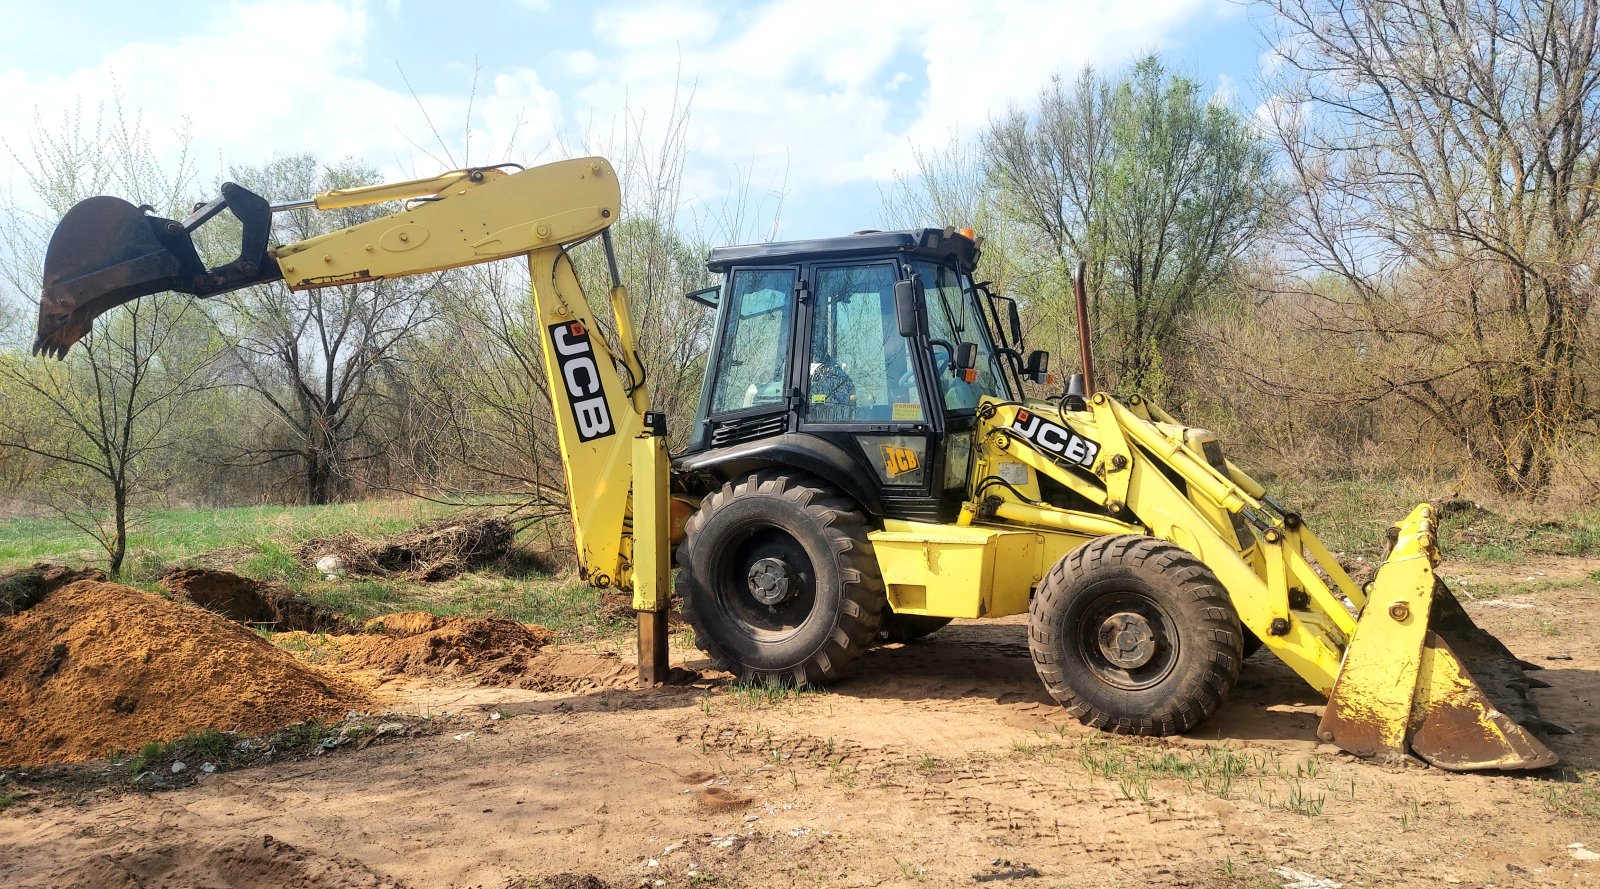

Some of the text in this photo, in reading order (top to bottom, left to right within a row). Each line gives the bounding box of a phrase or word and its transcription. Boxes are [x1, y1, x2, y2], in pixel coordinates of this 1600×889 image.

[553, 325, 611, 438] JCB
[885, 446, 918, 477] JCB
[1013, 416, 1098, 466] JCB
